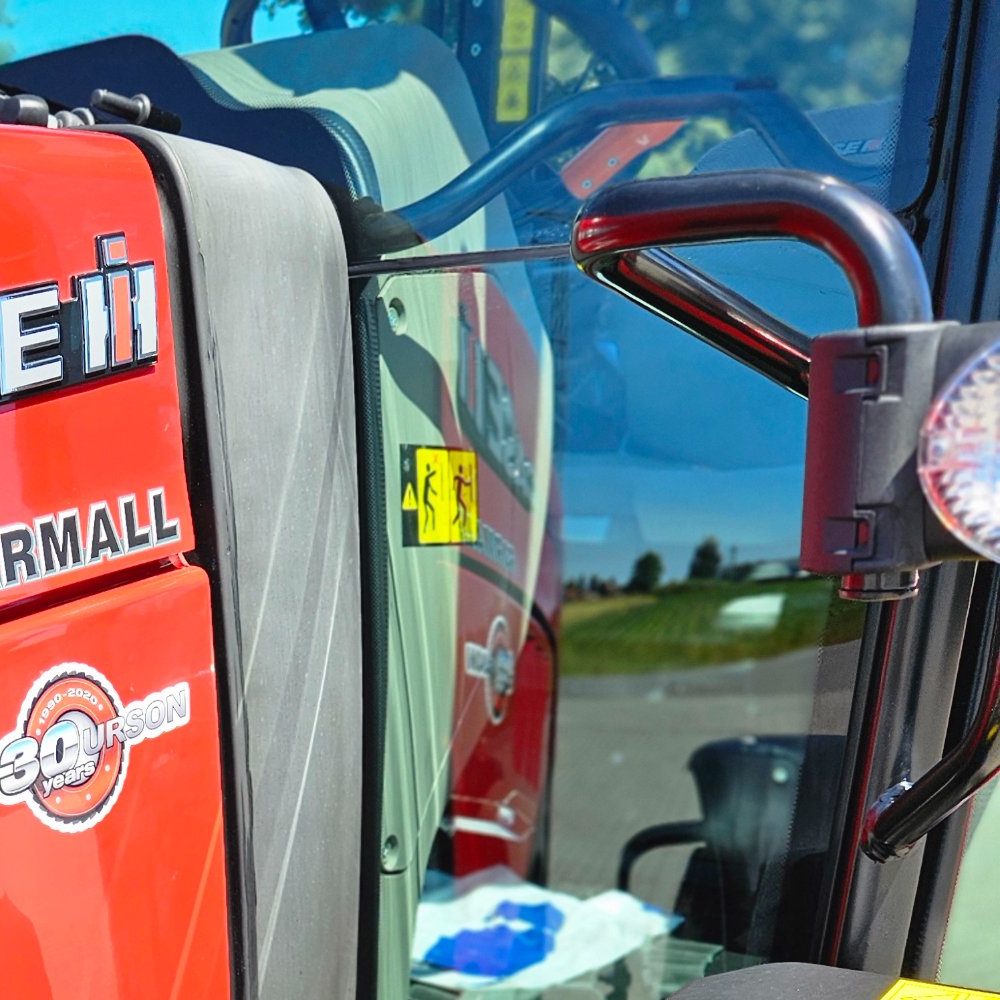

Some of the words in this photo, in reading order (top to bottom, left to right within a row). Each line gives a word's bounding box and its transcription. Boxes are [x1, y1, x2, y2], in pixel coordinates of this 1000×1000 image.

[39, 688, 98, 725] 1990-2020
[83, 690, 187, 756] URSON
[42, 761, 96, 799] years
